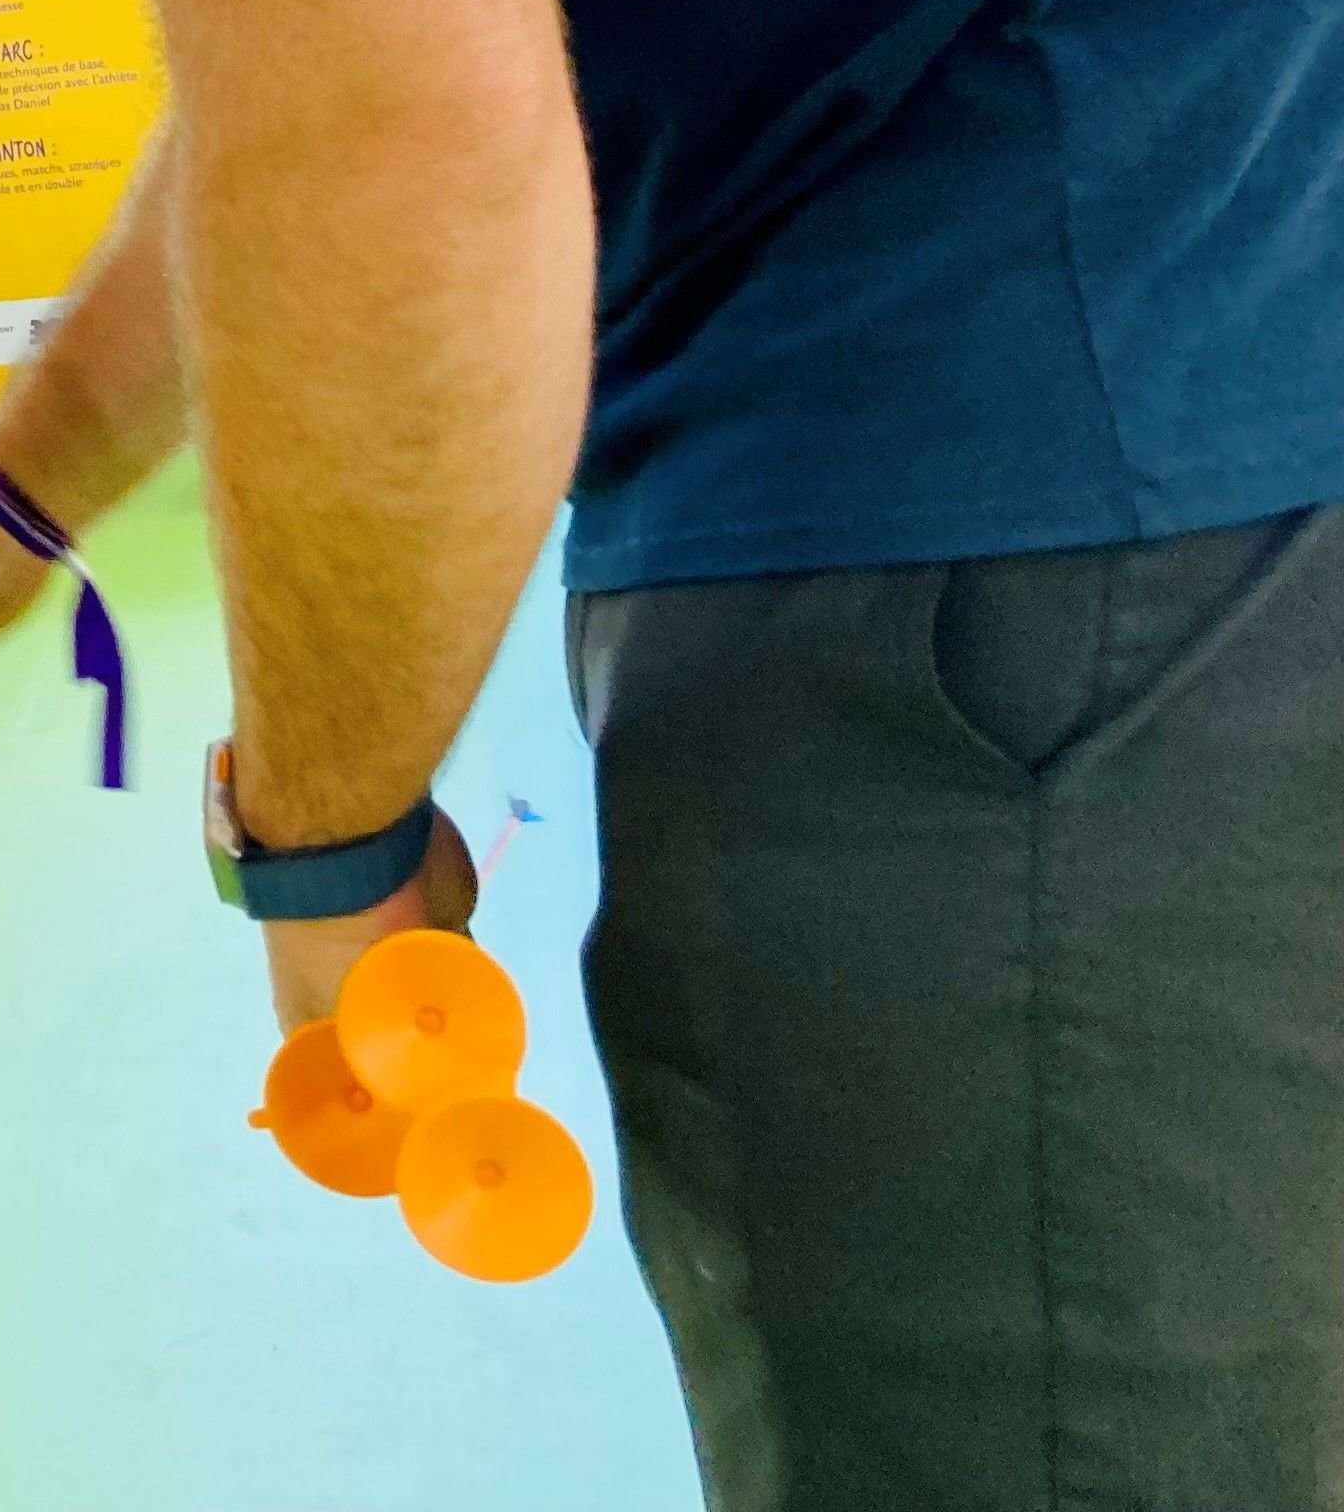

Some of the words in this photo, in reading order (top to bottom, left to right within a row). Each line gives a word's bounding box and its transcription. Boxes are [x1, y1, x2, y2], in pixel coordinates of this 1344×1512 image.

[0, 64, 58, 81] techniques
[62, 60, 76, 72] de
[79, 58, 107, 70] base,
[12, 79, 61, 98] précision
[64, 77, 89, 88] avec
[14, 95, 51, 109] Daniel
[14, 184, 26, 194] et
[28, 182, 42, 193] en
[45, 177, 82, 191] double
